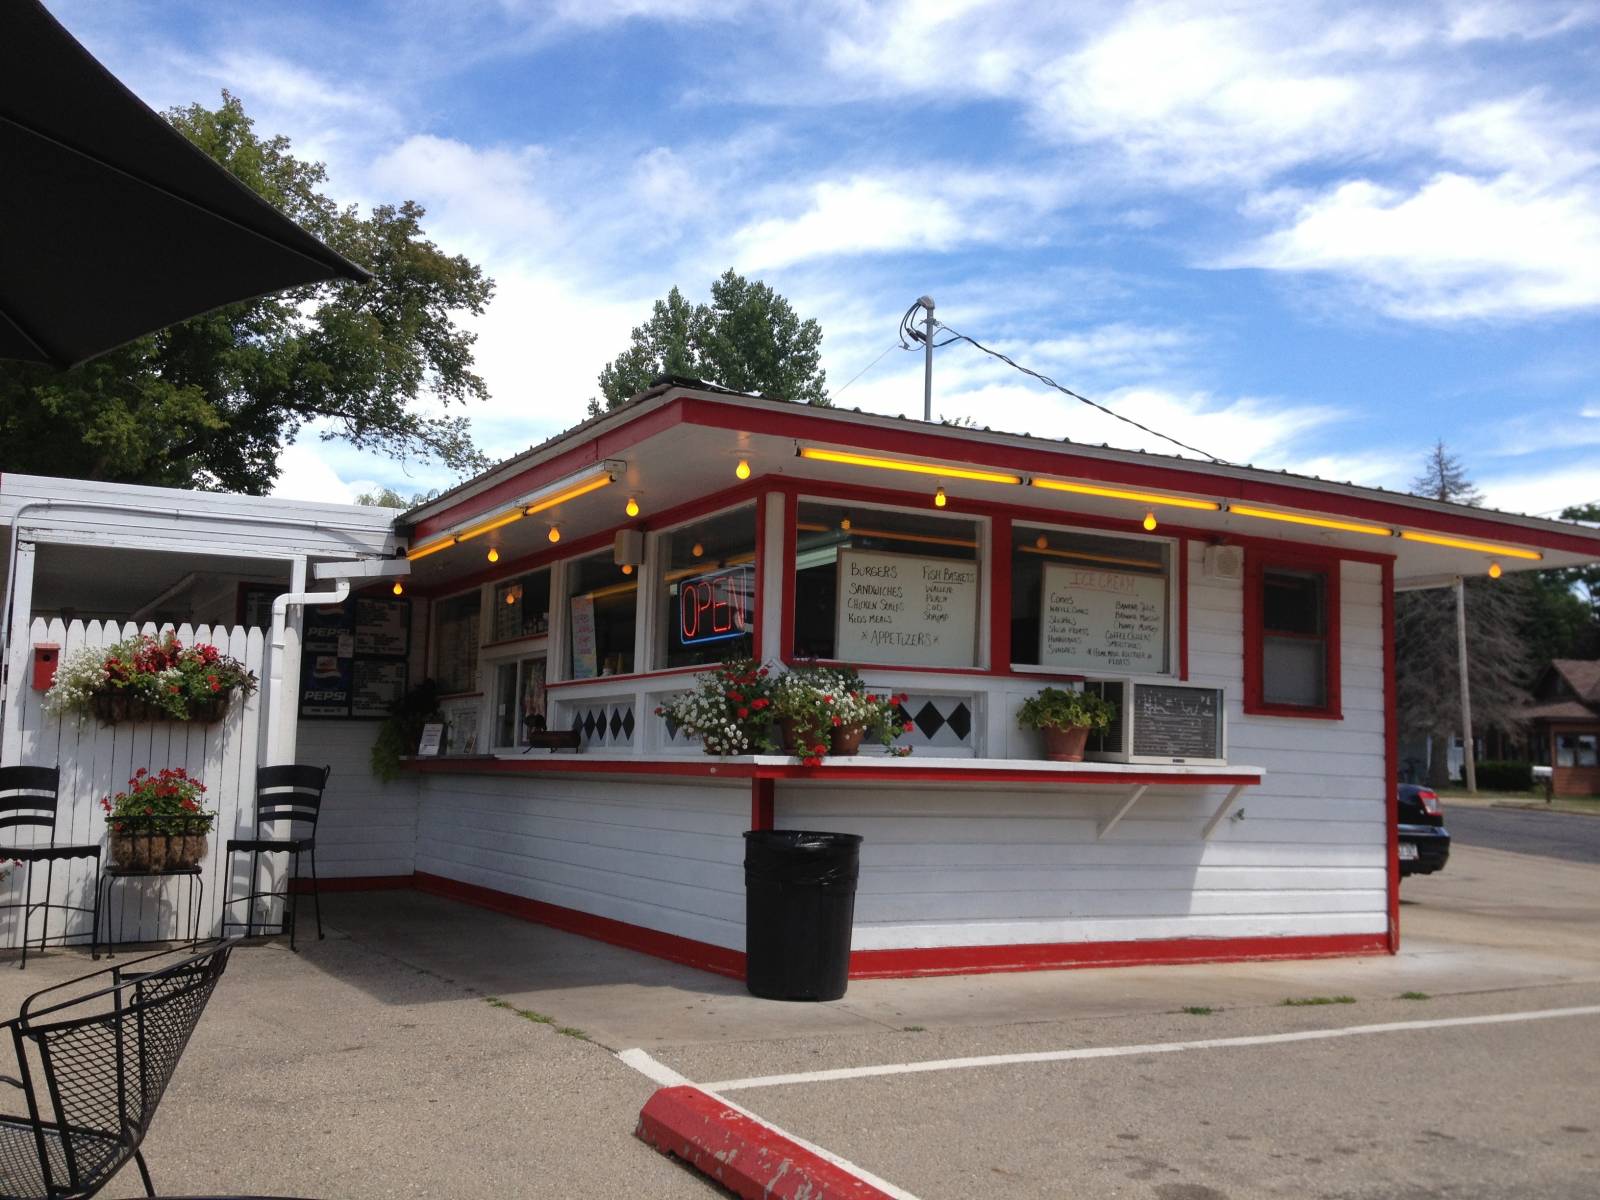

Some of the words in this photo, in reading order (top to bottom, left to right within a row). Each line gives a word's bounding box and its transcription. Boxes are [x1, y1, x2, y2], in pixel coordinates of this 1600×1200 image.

[851, 562, 898, 578] BURGERS
[923, 566, 941, 581] FISH
[1070, 572, 1095, 586] ICE
[849, 583, 903, 598] SANDWICHES
[682, 576, 746, 637] OPEN
[869, 614, 893, 624] MEALS
[307, 627, 351, 637] PEPSI
[871, 630, 932, 647] APPETIZERS
[304, 691, 347, 701] PEPSI
